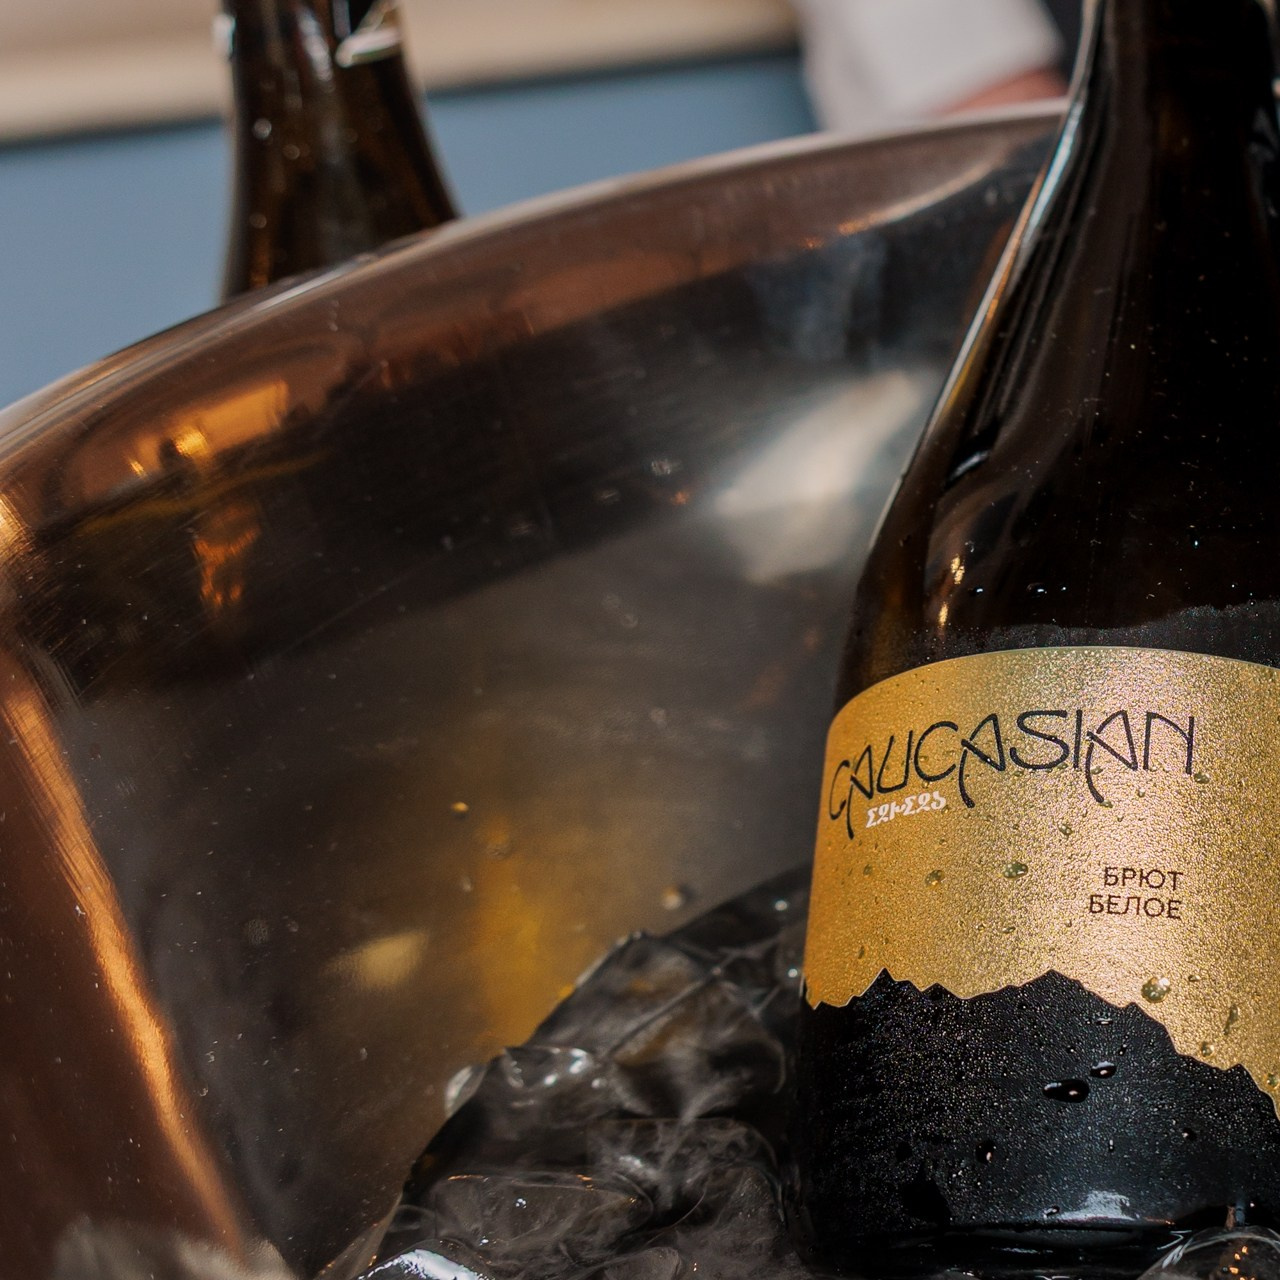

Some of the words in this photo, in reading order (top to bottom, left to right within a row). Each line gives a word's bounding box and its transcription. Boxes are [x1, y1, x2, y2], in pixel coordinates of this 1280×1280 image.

[829, 709, 1195, 839] CAUCASIAN
[1104, 867, 1184, 891] БРЮТ
[1089, 894, 1182, 920] БЕЛОЕ
